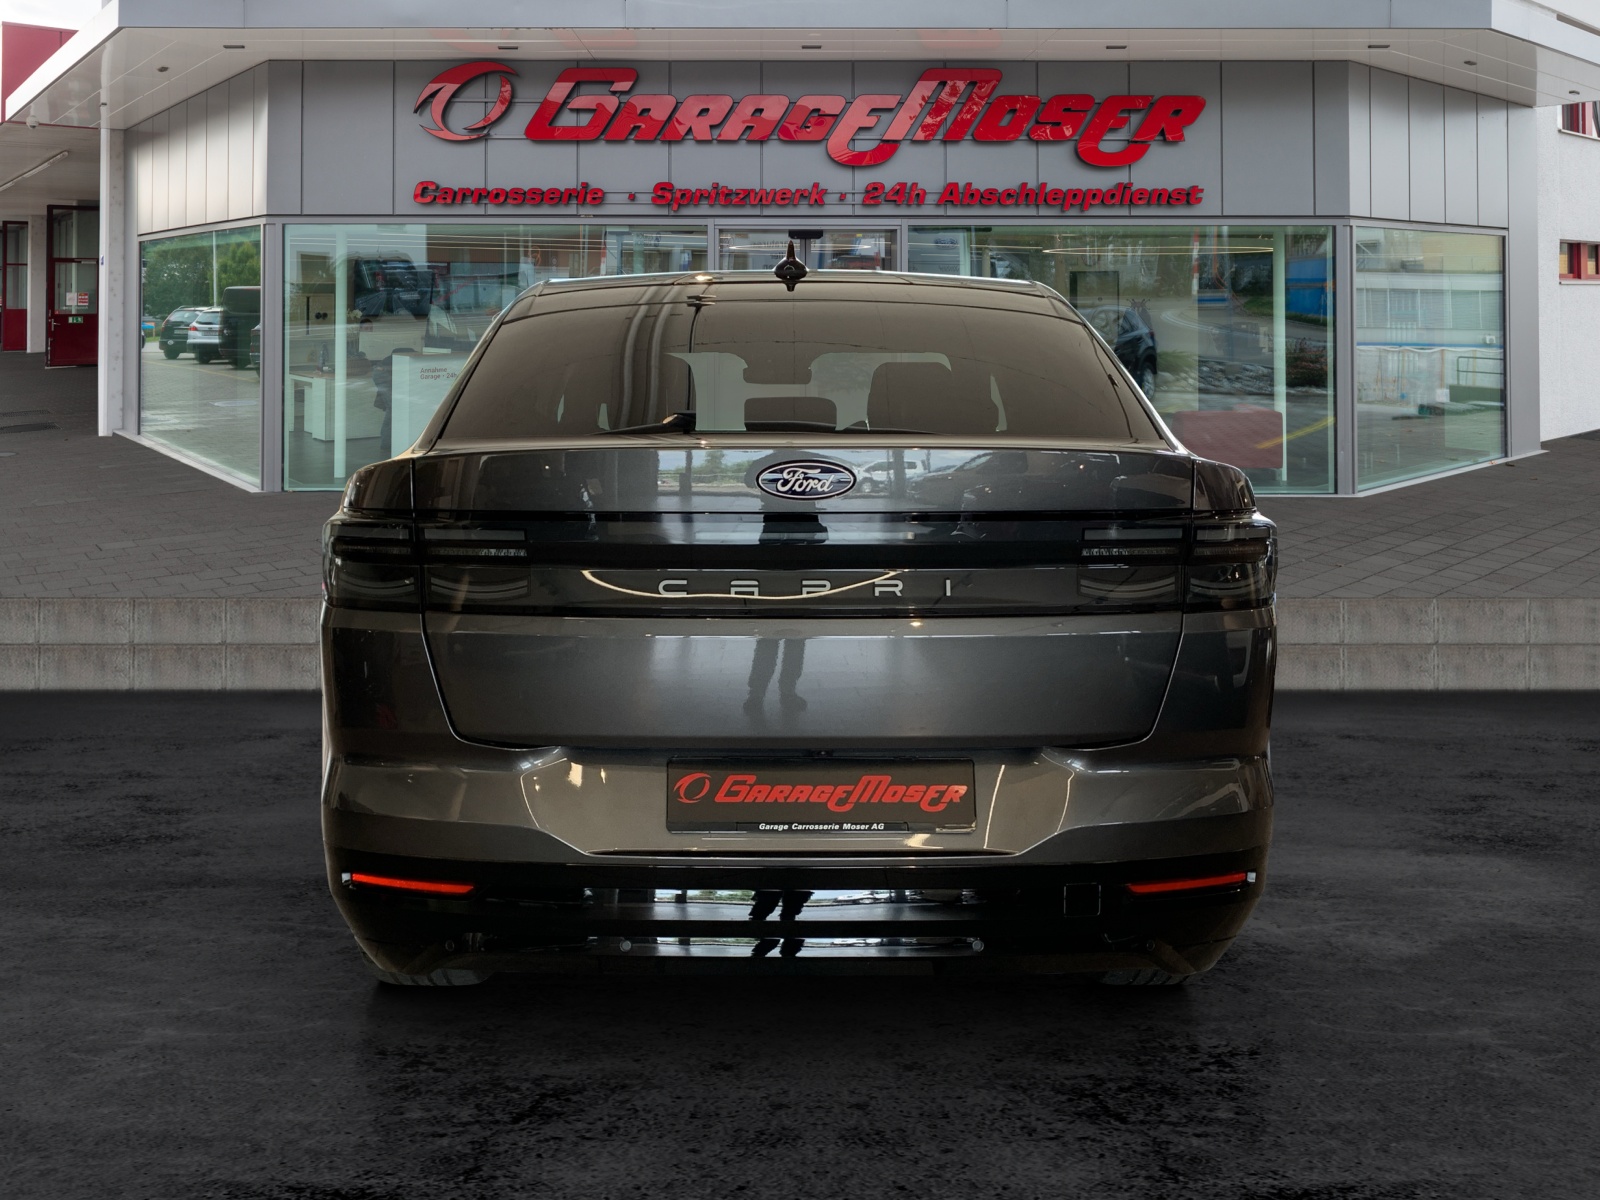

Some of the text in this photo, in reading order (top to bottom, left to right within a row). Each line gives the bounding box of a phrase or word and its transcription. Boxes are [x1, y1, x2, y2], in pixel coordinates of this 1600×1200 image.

[413, 180, 605, 206] Carrosserie
[651, 181, 827, 211] Spritzwerk
[862, 181, 927, 206] 24h
[937, 181, 1204, 212] Abschleppdienst
[777, 467, 834, 492] Ford
[658, 579, 951, 597] CAPRI
[758, 823, 789, 831] Garage
